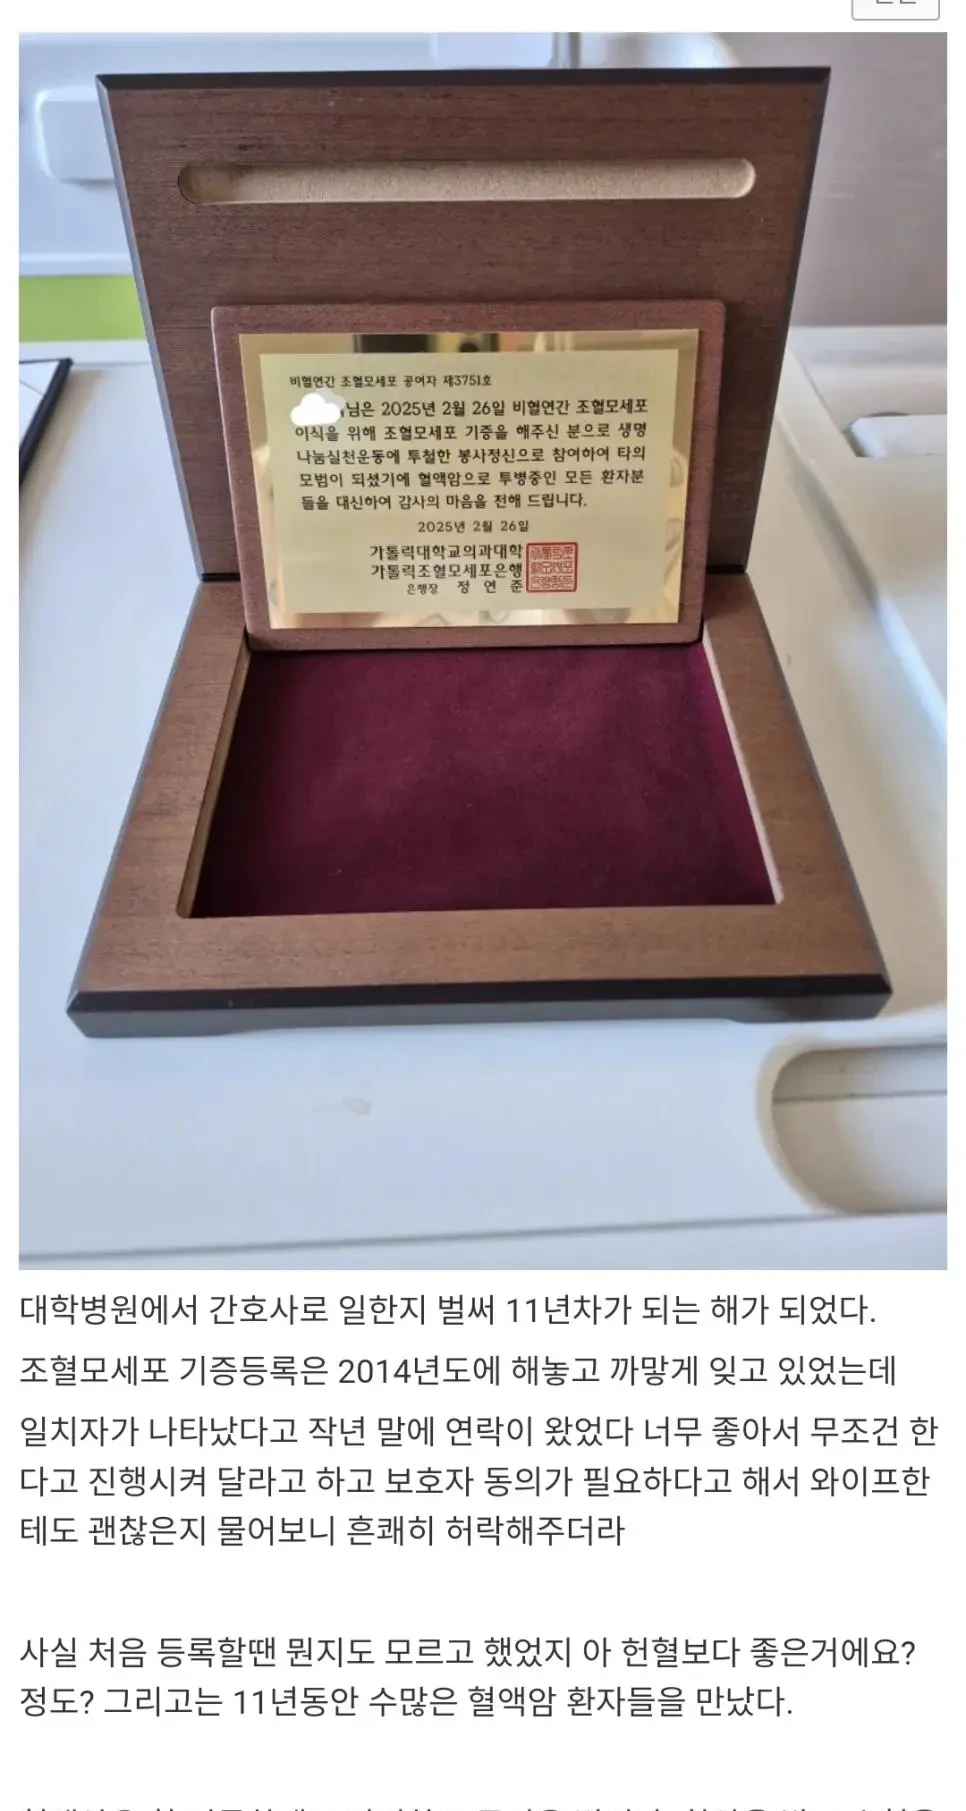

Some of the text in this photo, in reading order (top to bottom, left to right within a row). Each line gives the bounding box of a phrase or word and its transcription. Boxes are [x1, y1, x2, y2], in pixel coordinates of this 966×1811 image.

[289, 374, 492, 389] 비혈연간 조혈모세포 공여자 제3751호
[381, 401, 436, 417] 2025년
[442, 400, 465, 417] 2월
[472, 400, 505, 416] 26일
[512, 400, 570, 416] 비혈연간
[576, 398, 648, 415] 조혈모세포
[294, 422, 647, 442] 이식을 위해 조혈모세포 기증을 해주신 분으로 생명
[296, 446, 646, 465] 나눔실천운동에 투철한 봉사정신으로 참여하여 타의
[300, 468, 644, 488] 모범이 되셨기에 혈액암으로 투병중인 모든 환자분
[301, 492, 587, 511] 들을 대신하여 감사의 마음을 전해 드립니다.
[418, 520, 529, 533] 2025년 2월 26일
[370, 544, 523, 561] 가톨릭대학교의과대학
[371, 563, 522, 580] 가톨릭조혈모세포은행
